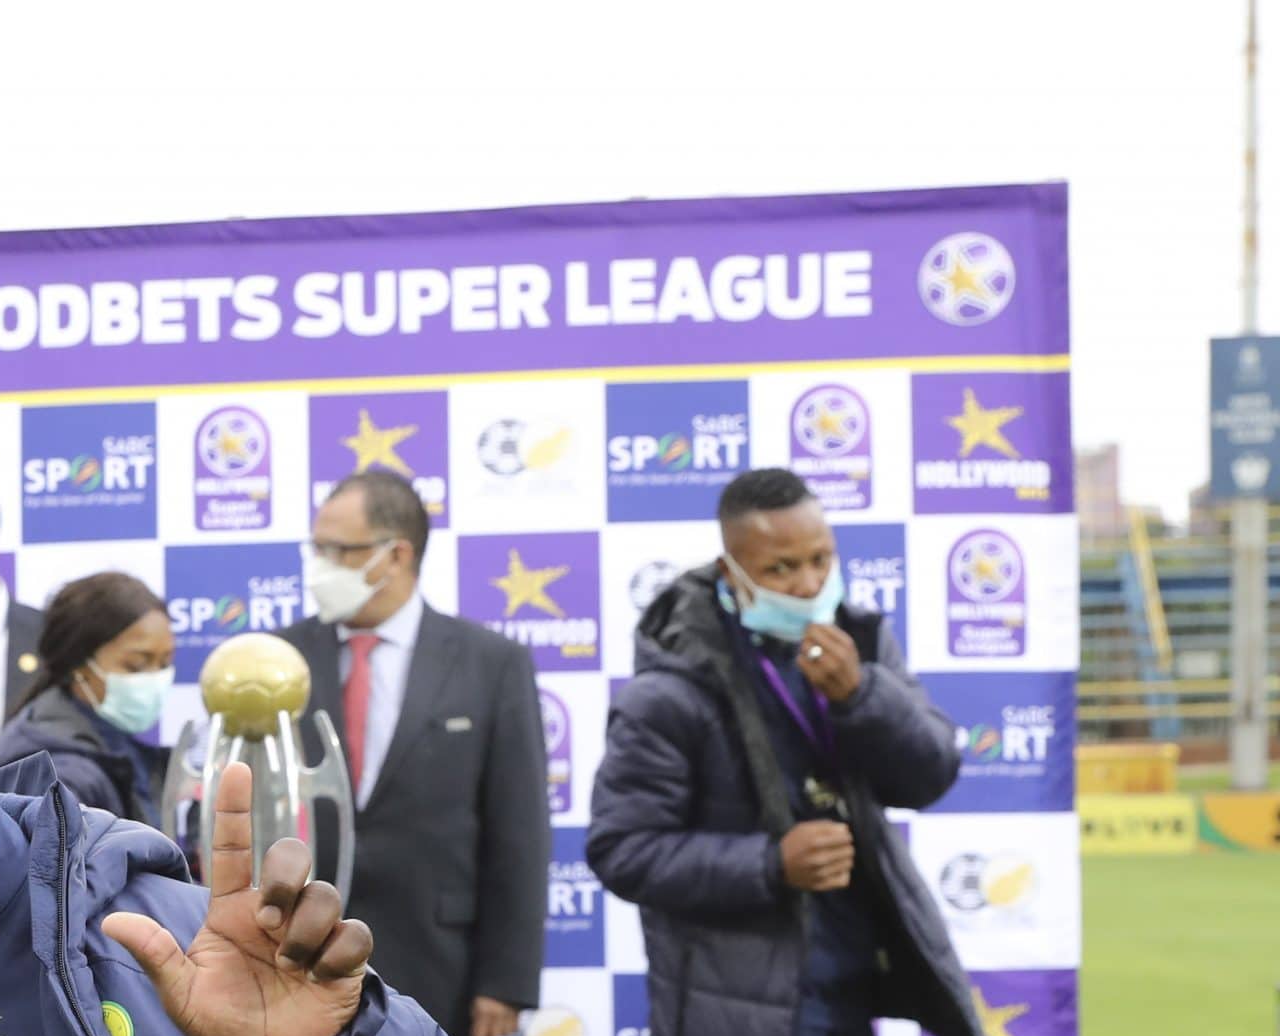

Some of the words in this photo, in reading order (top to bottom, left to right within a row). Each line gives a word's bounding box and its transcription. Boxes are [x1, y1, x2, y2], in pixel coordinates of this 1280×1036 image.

[291, 263, 551, 338] SUPER
[565, 250, 872, 327] LEAGUE
[692, 413, 746, 433] SABC
[103, 436, 154, 453] SABC
[607, 434, 747, 472] SPORT
[23, 454, 155, 494] SPORT
[916, 459, 1052, 488] HOLLYWOOD
[207, 498, 258, 516] Super
[848, 557, 904, 578] SABC
[248, 575, 300, 595] SABC
[168, 596, 300, 632] SPORT
[1002, 704, 1055, 726] SABC
